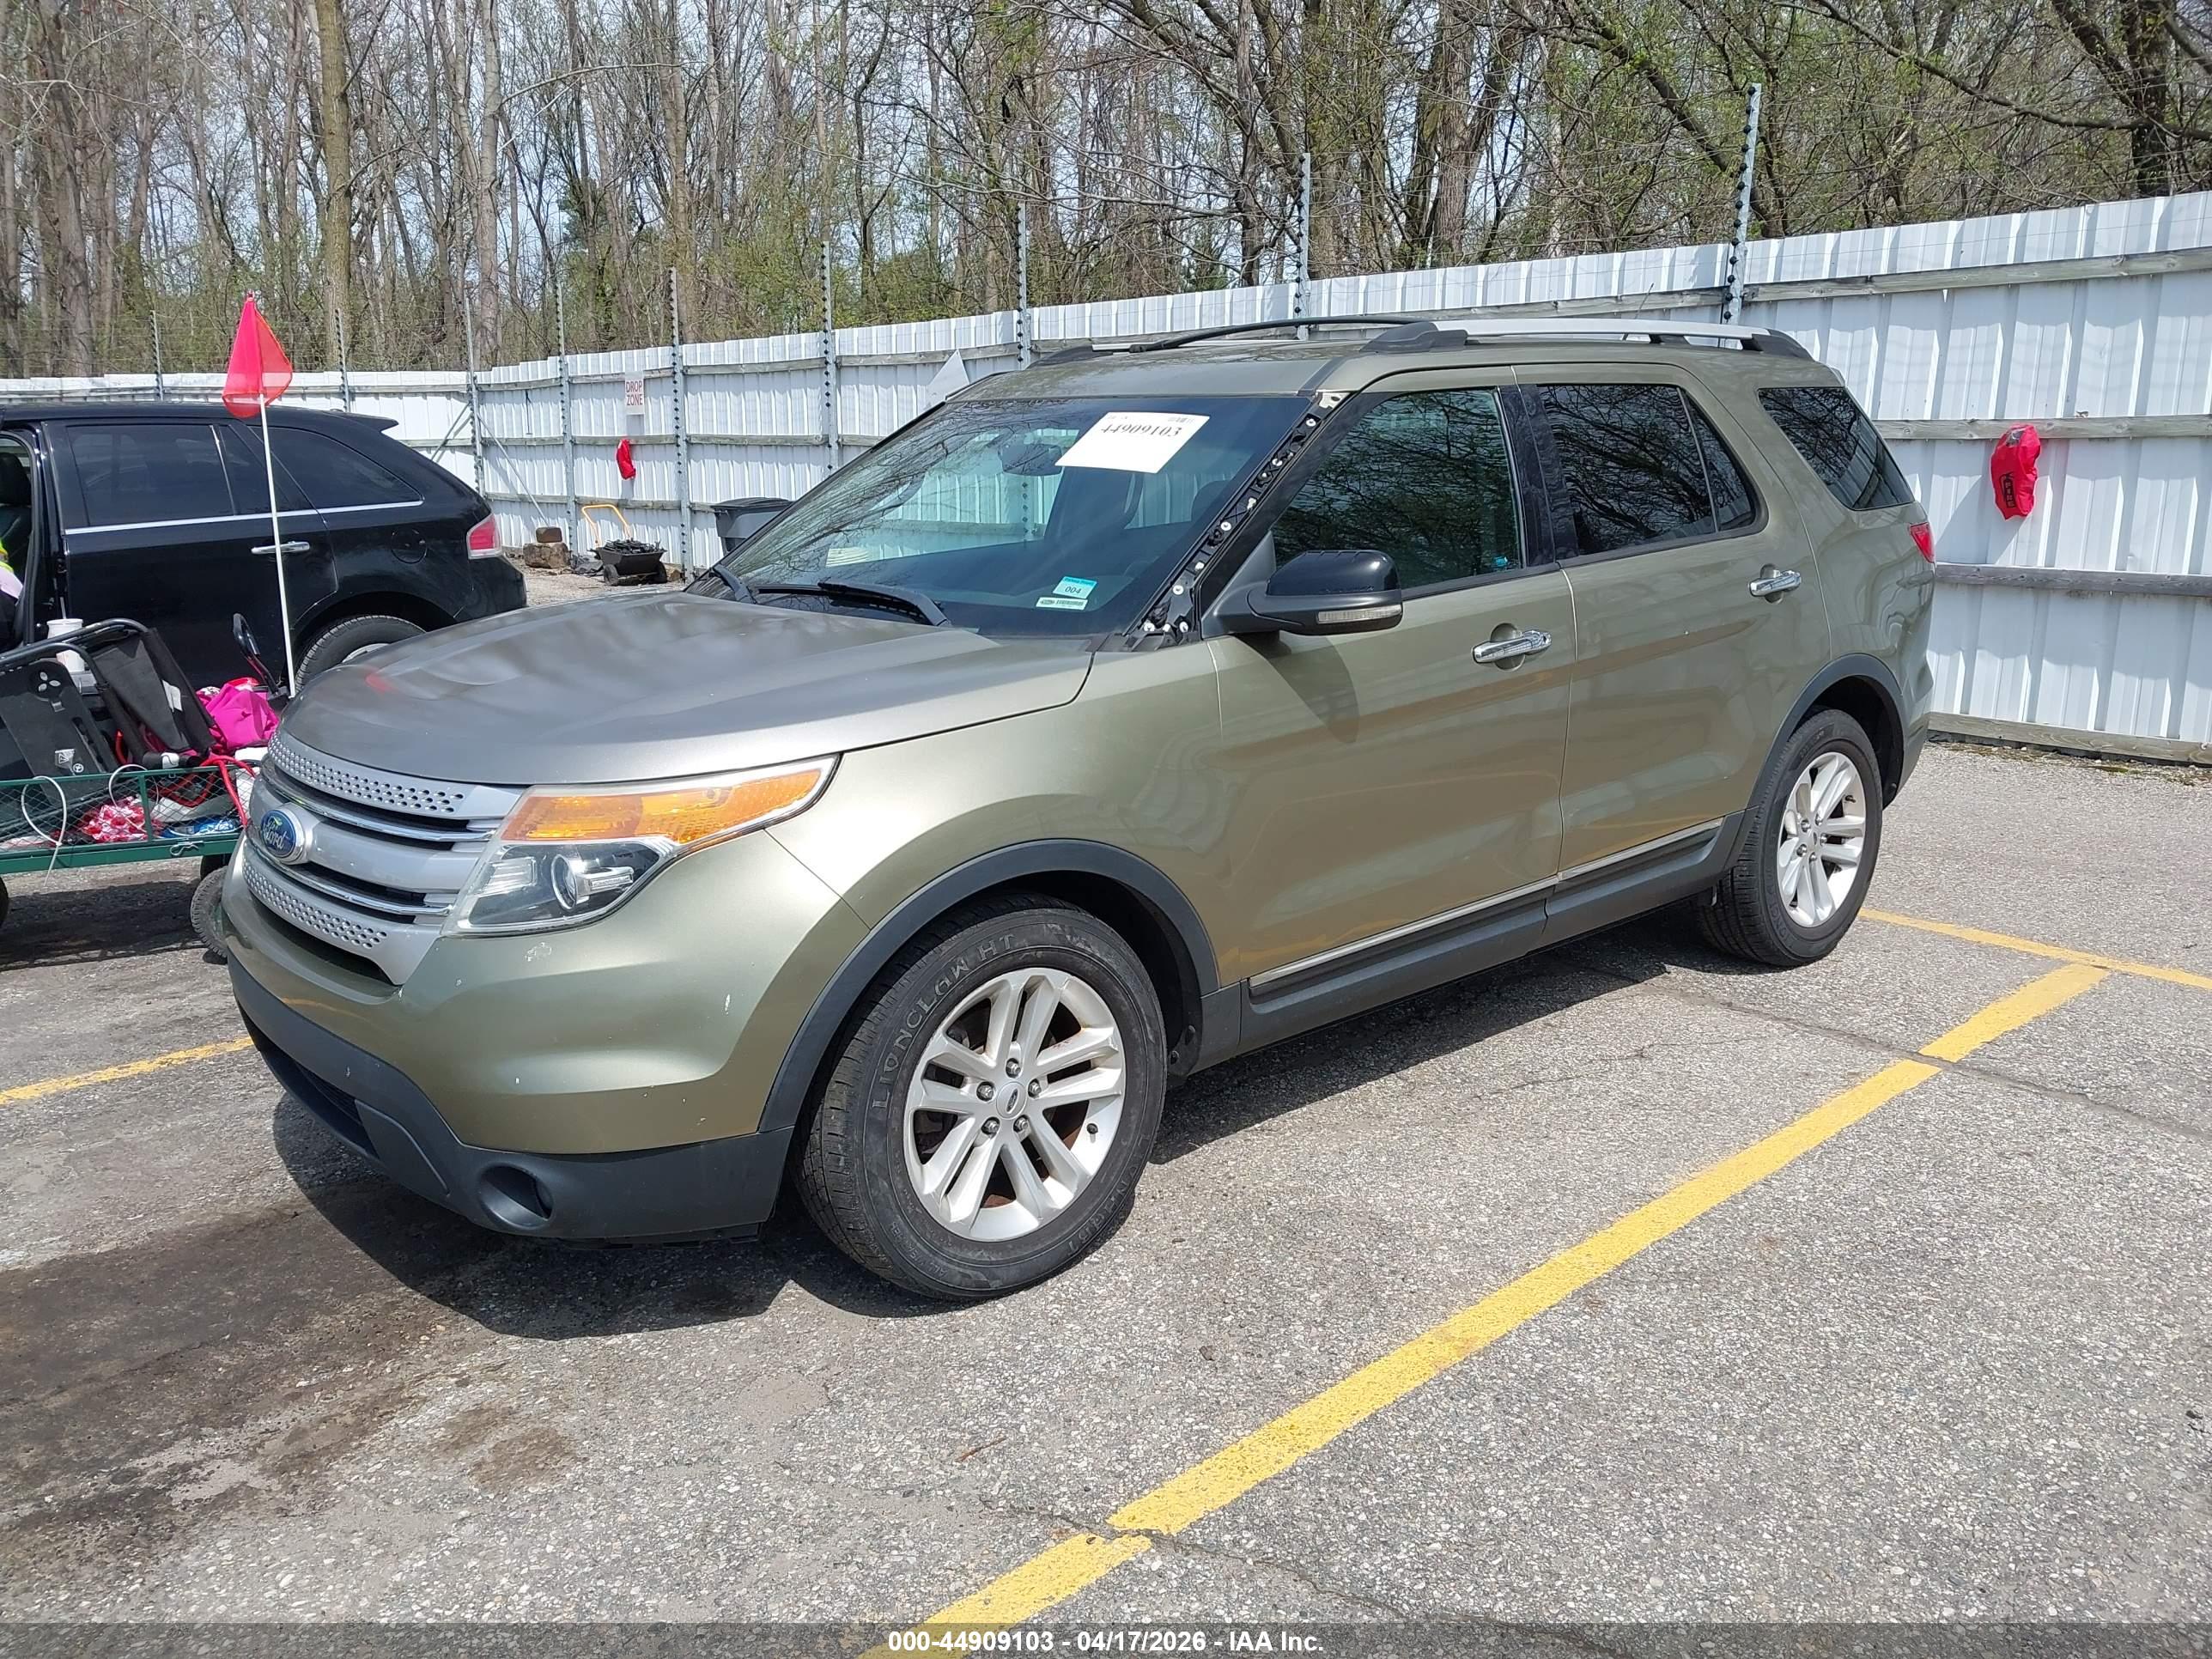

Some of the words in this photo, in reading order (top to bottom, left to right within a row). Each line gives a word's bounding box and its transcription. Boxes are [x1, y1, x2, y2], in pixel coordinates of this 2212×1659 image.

[626, 380, 643, 392] DROP
[626, 394, 643, 405] ZONE
[1101, 422, 1183, 437] 44909103
[1065, 586, 1082, 594] 004
[262, 816, 287, 850] Ford
[872, 958, 970, 1109] LIONCLAW
[977, 933, 1015, 961] HT
